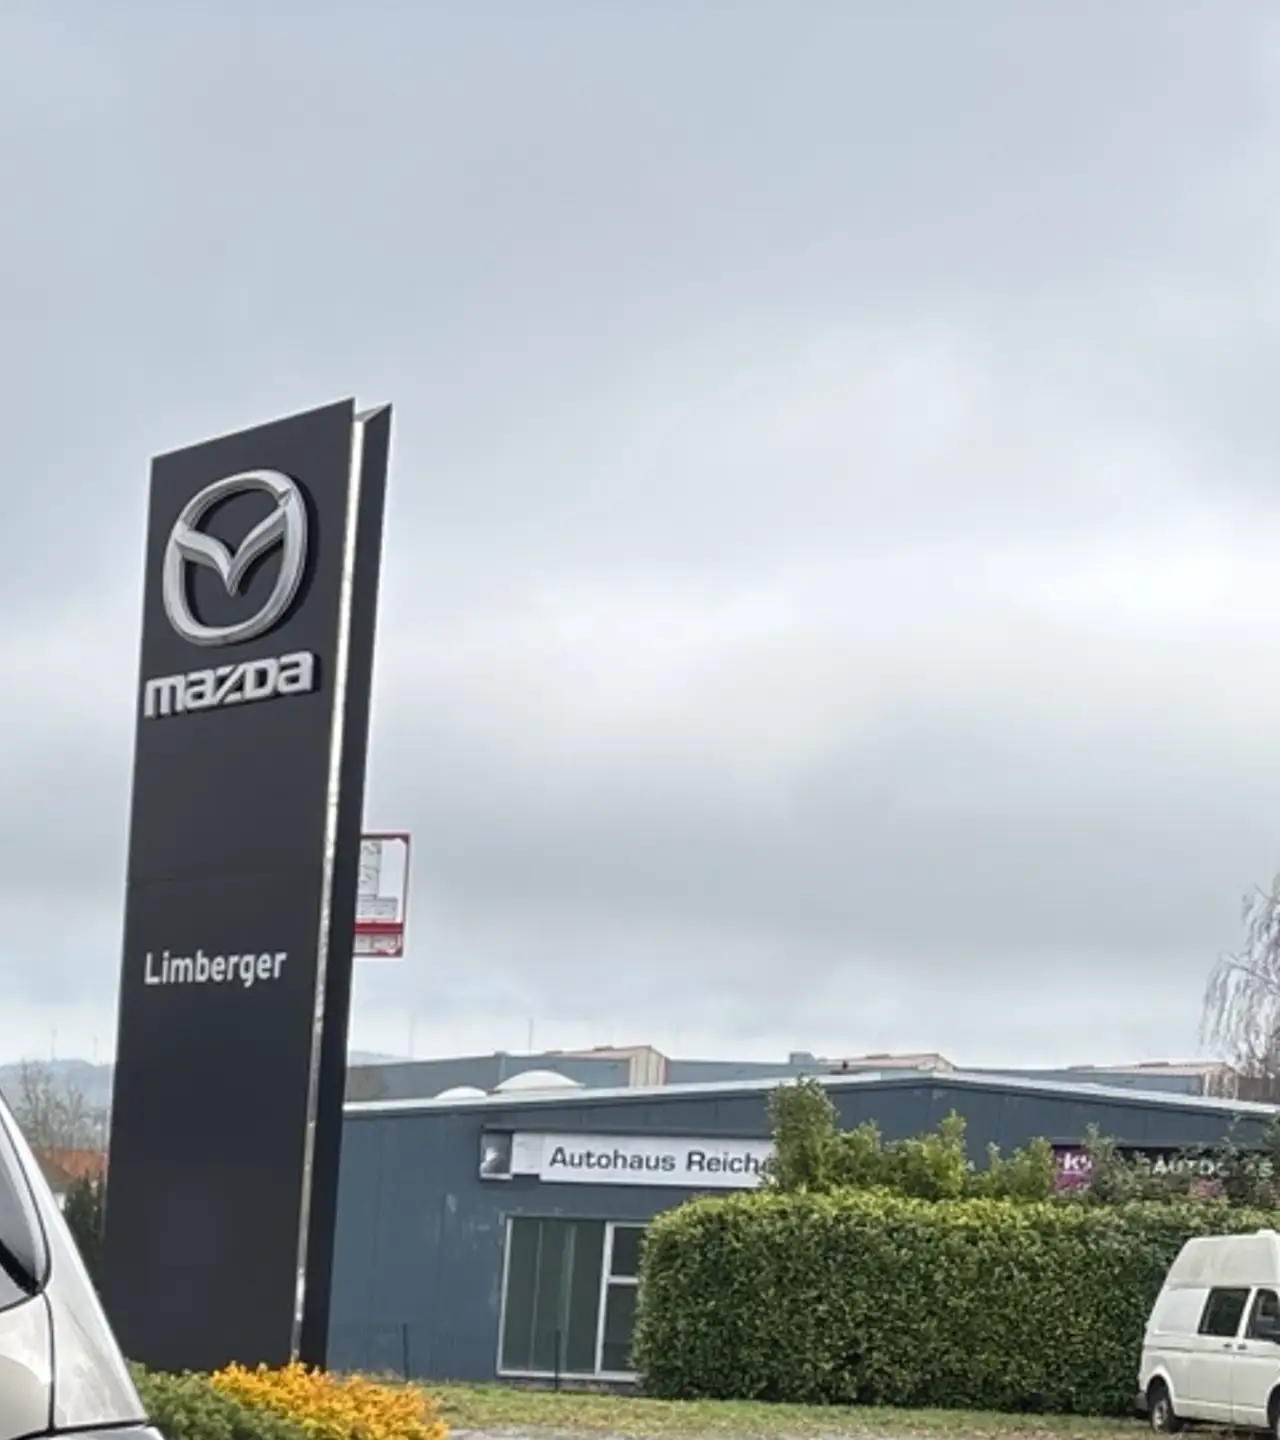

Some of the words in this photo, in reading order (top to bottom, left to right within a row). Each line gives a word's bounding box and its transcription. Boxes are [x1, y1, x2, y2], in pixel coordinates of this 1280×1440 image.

[143, 650, 315, 717] mazda
[144, 949, 287, 988] Limberger
[549, 1147, 676, 1172] Autohaus
